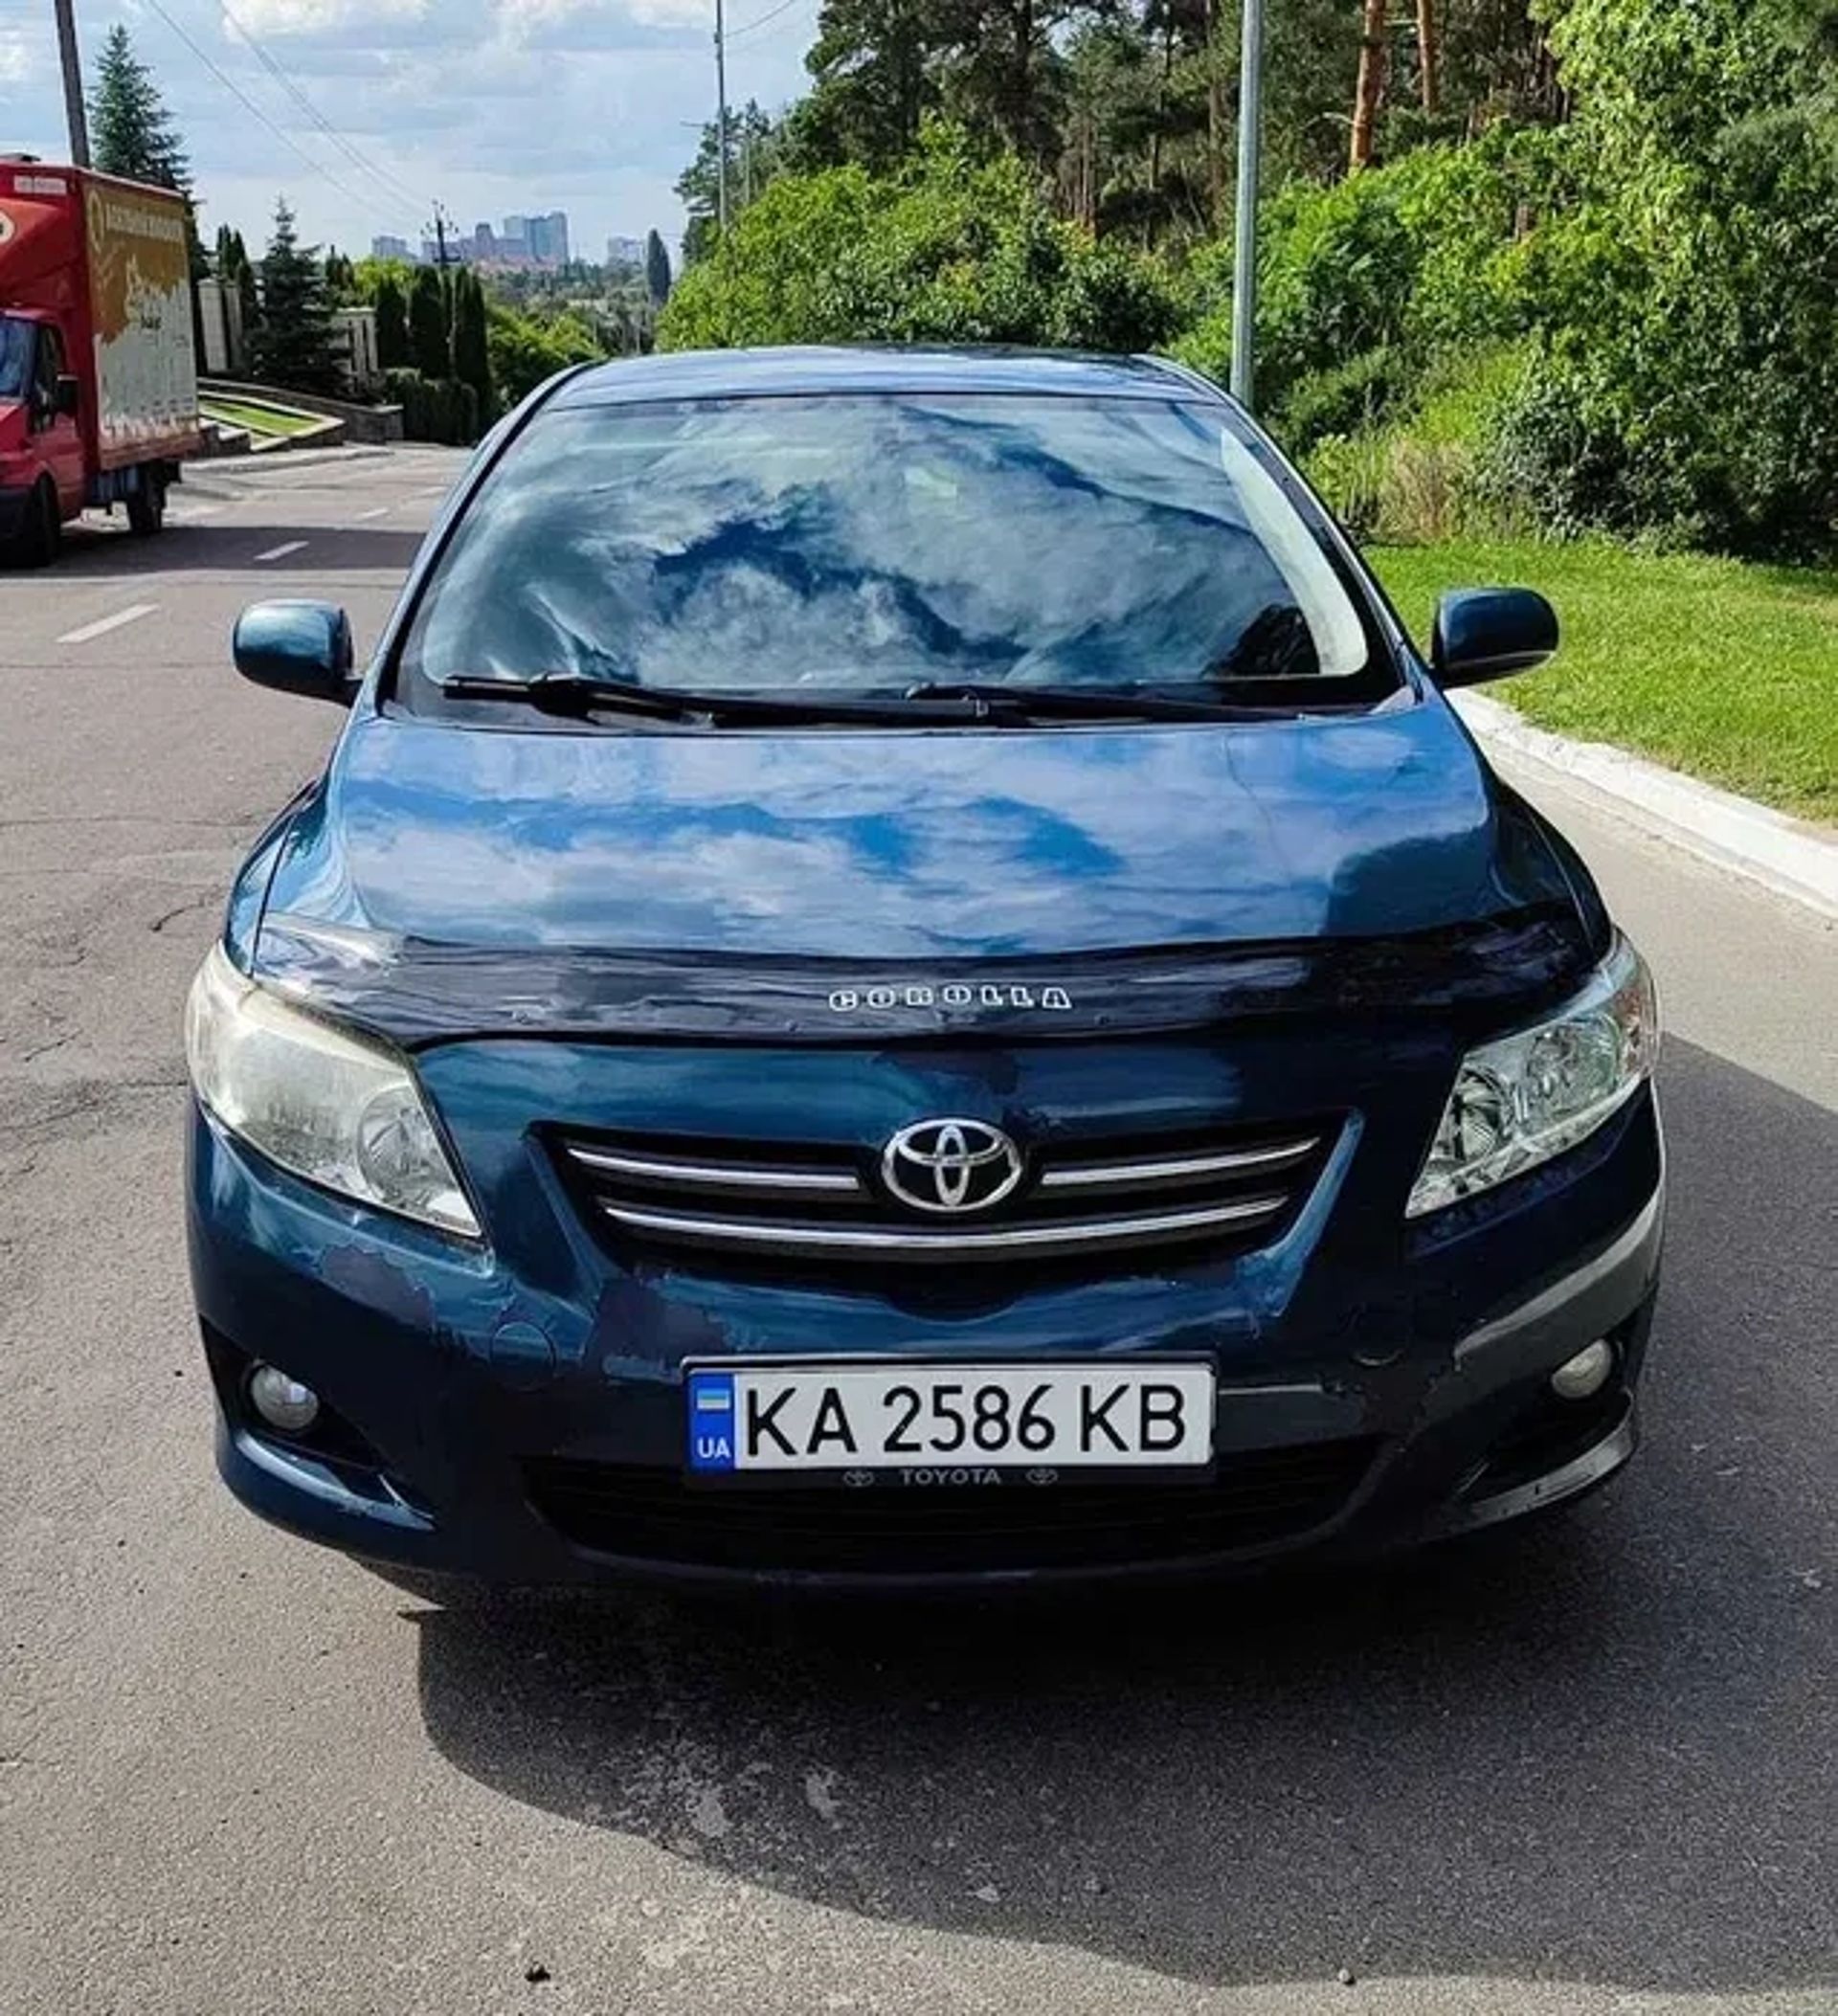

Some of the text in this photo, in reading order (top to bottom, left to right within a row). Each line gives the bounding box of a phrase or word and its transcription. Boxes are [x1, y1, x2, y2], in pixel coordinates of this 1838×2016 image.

[829, 985, 1072, 1012] COROLLA
[746, 1385, 1186, 1456] KA 2586 KB
[697, 1439, 730, 1459] UA
[901, 1468, 1001, 1486] TOYOTA
